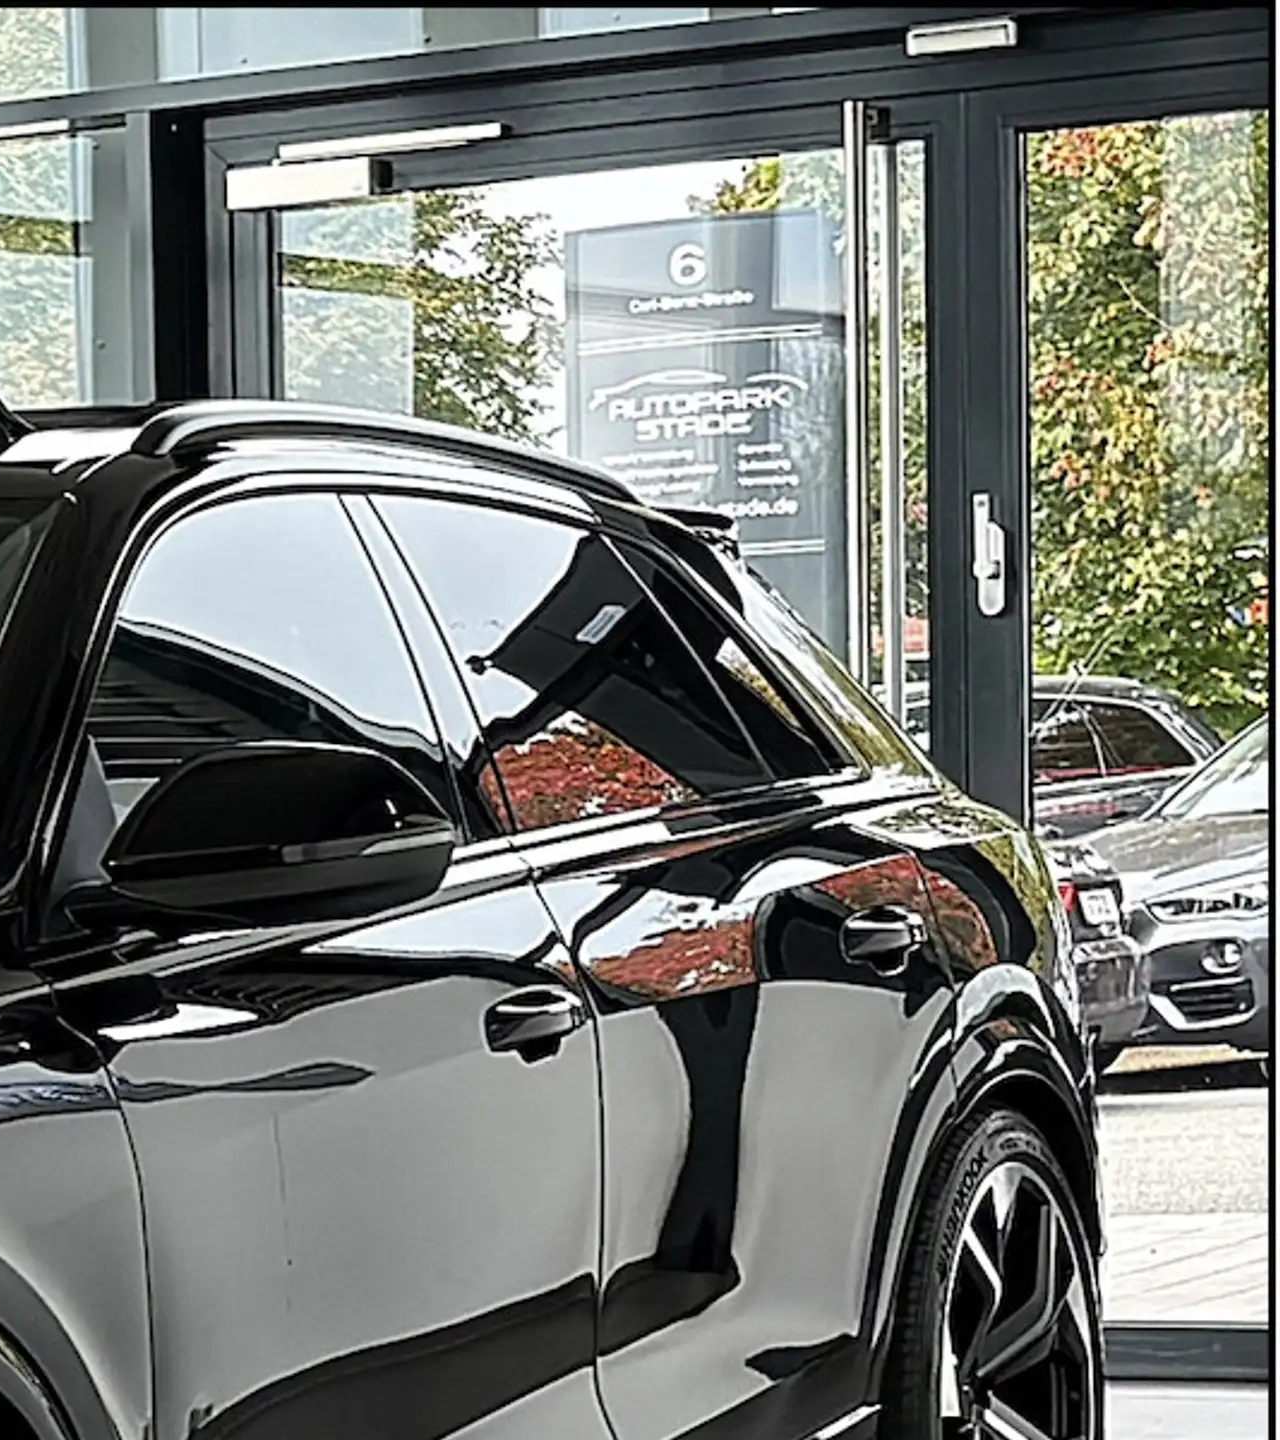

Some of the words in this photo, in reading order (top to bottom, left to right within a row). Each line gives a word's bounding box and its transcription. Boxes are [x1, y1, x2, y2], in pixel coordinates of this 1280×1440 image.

[669, 243, 707, 286] 6
[609, 386, 791, 421] AUTOPARK
[635, 412, 753, 442] STADE
